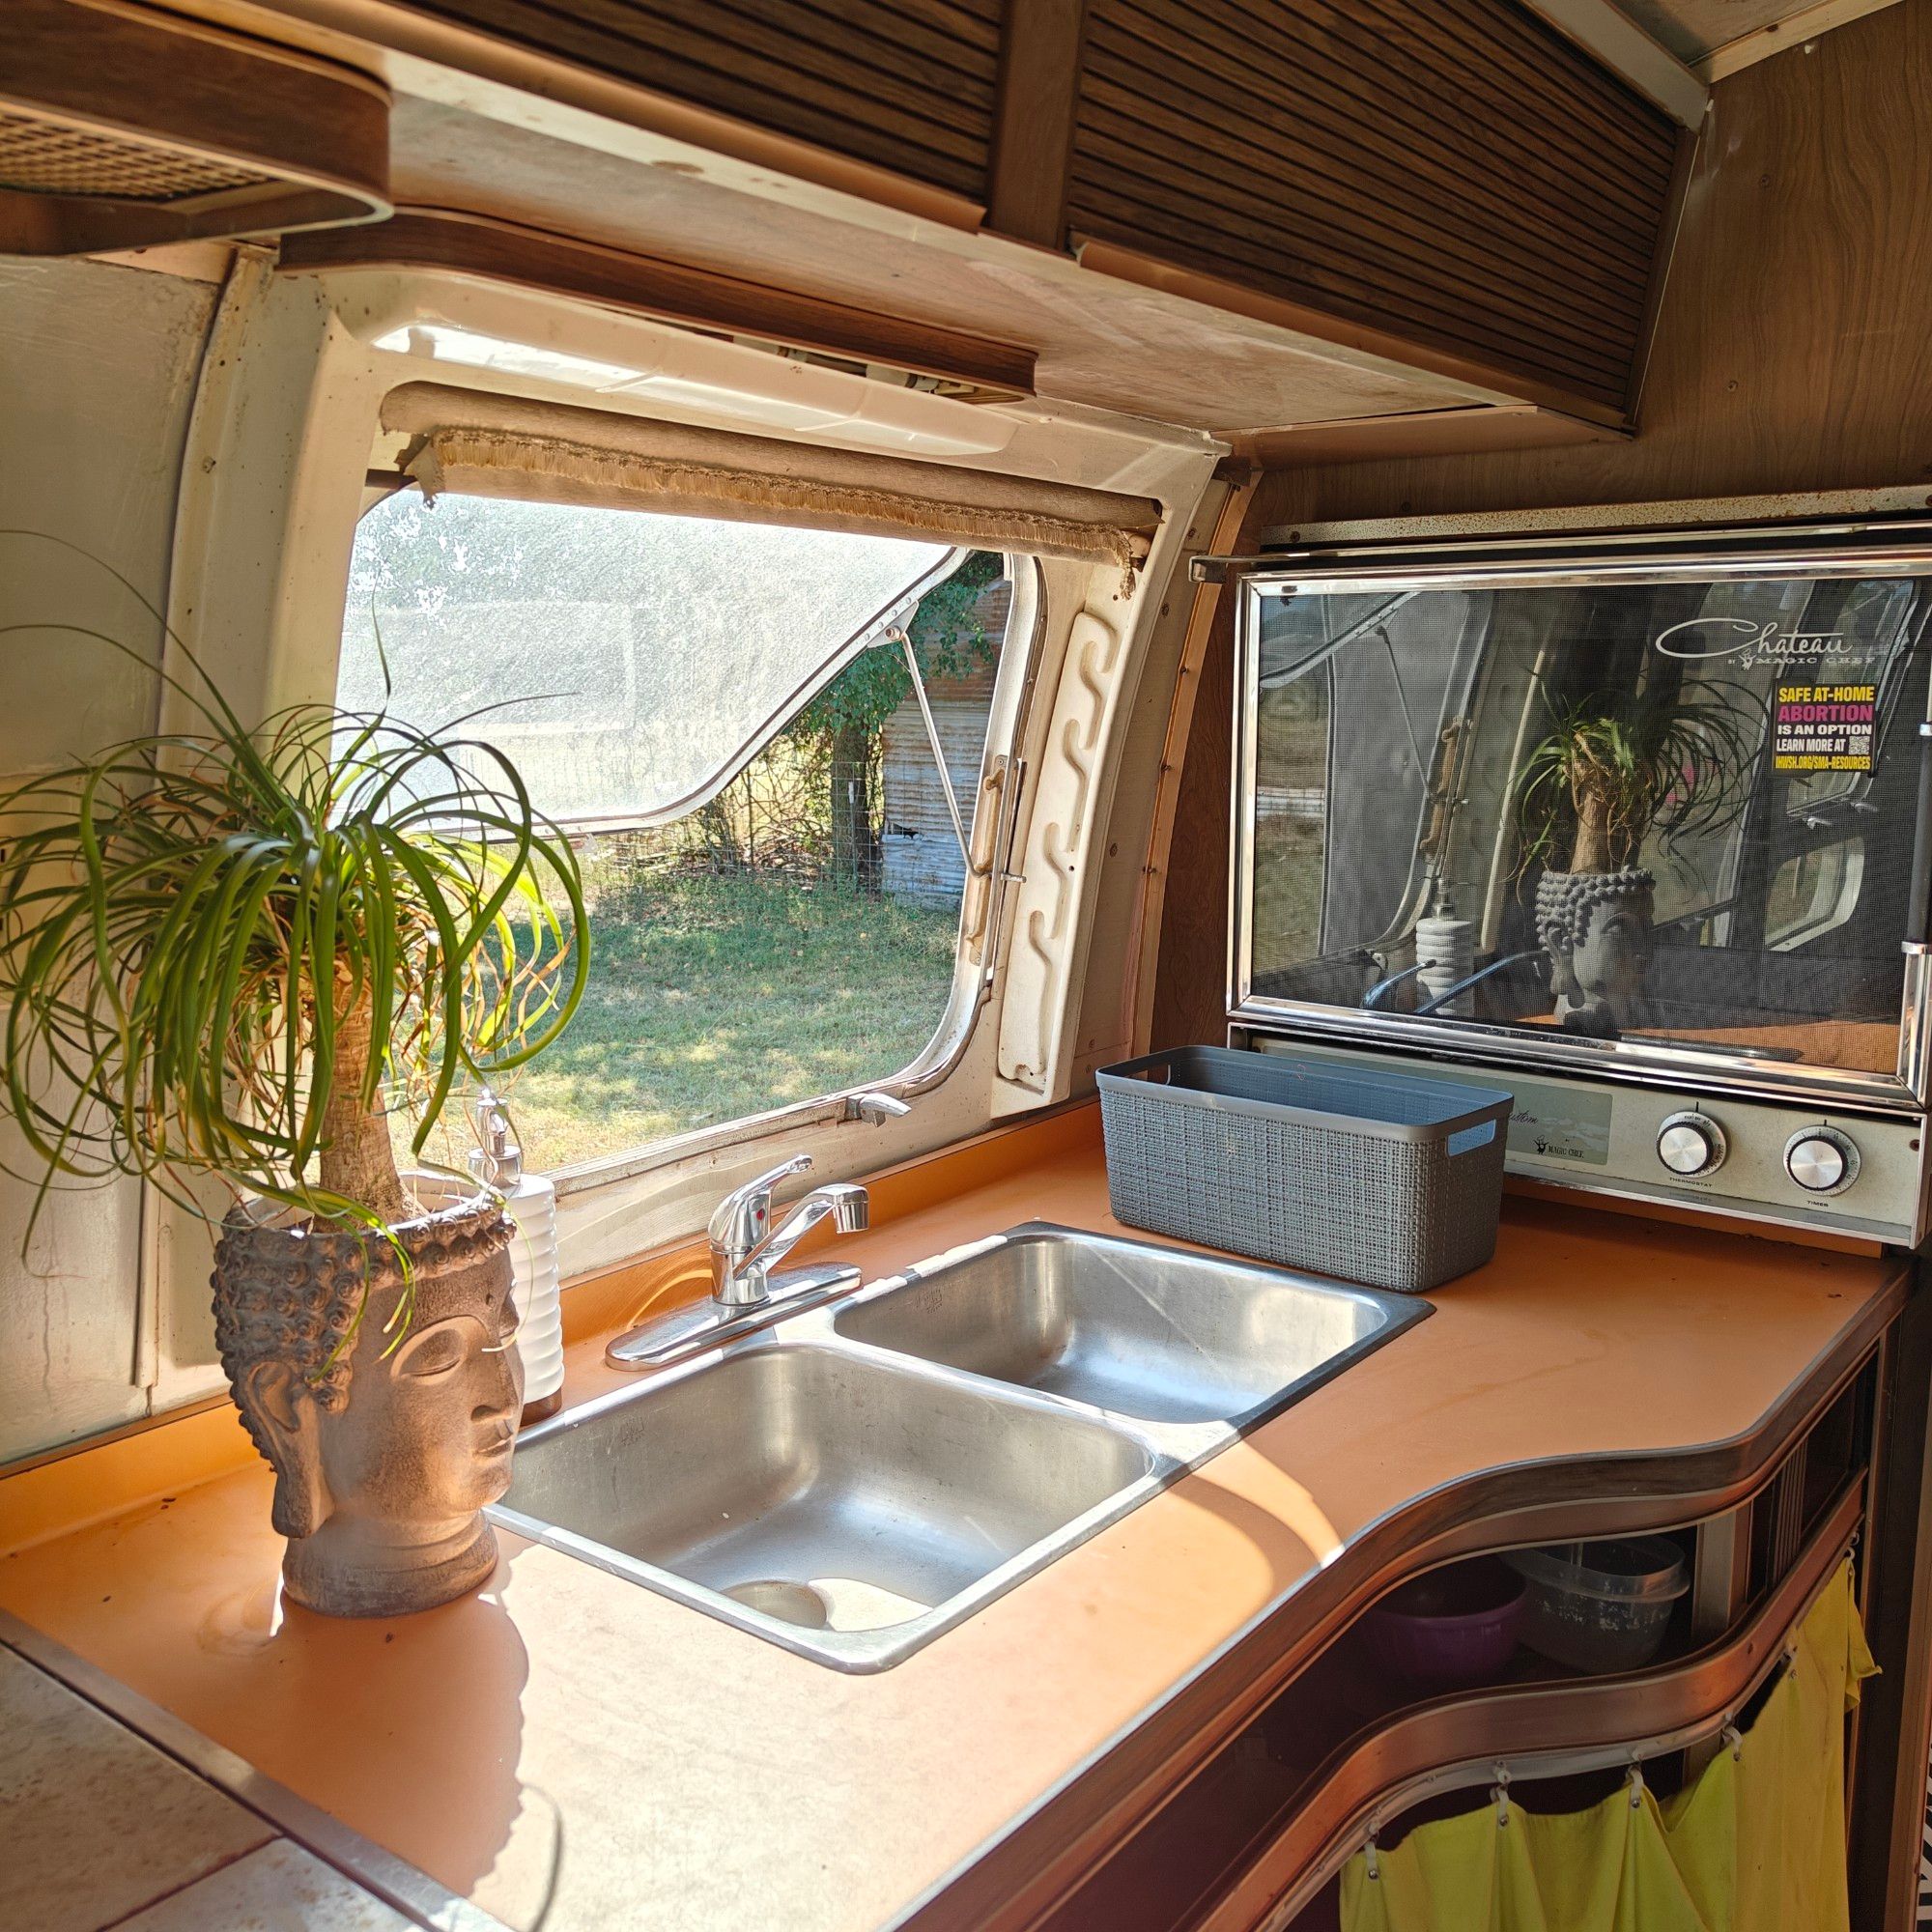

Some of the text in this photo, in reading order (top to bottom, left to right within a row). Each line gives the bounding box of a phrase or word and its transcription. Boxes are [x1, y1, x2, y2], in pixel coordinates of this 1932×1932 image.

[1656, 617, 1853, 659] Chateau
[1778, 686, 1875, 702] SAFE AT-HOME
[1777, 704, 1873, 722] ABORTION
[1777, 724, 1872, 735] IS AN OPTION
[1776, 738, 1846, 752] LEARN MORE AT
[1548, 1145, 1567, 1155] MAGIC
[1669, 1177, 1713, 1187] THERMOSTAT
